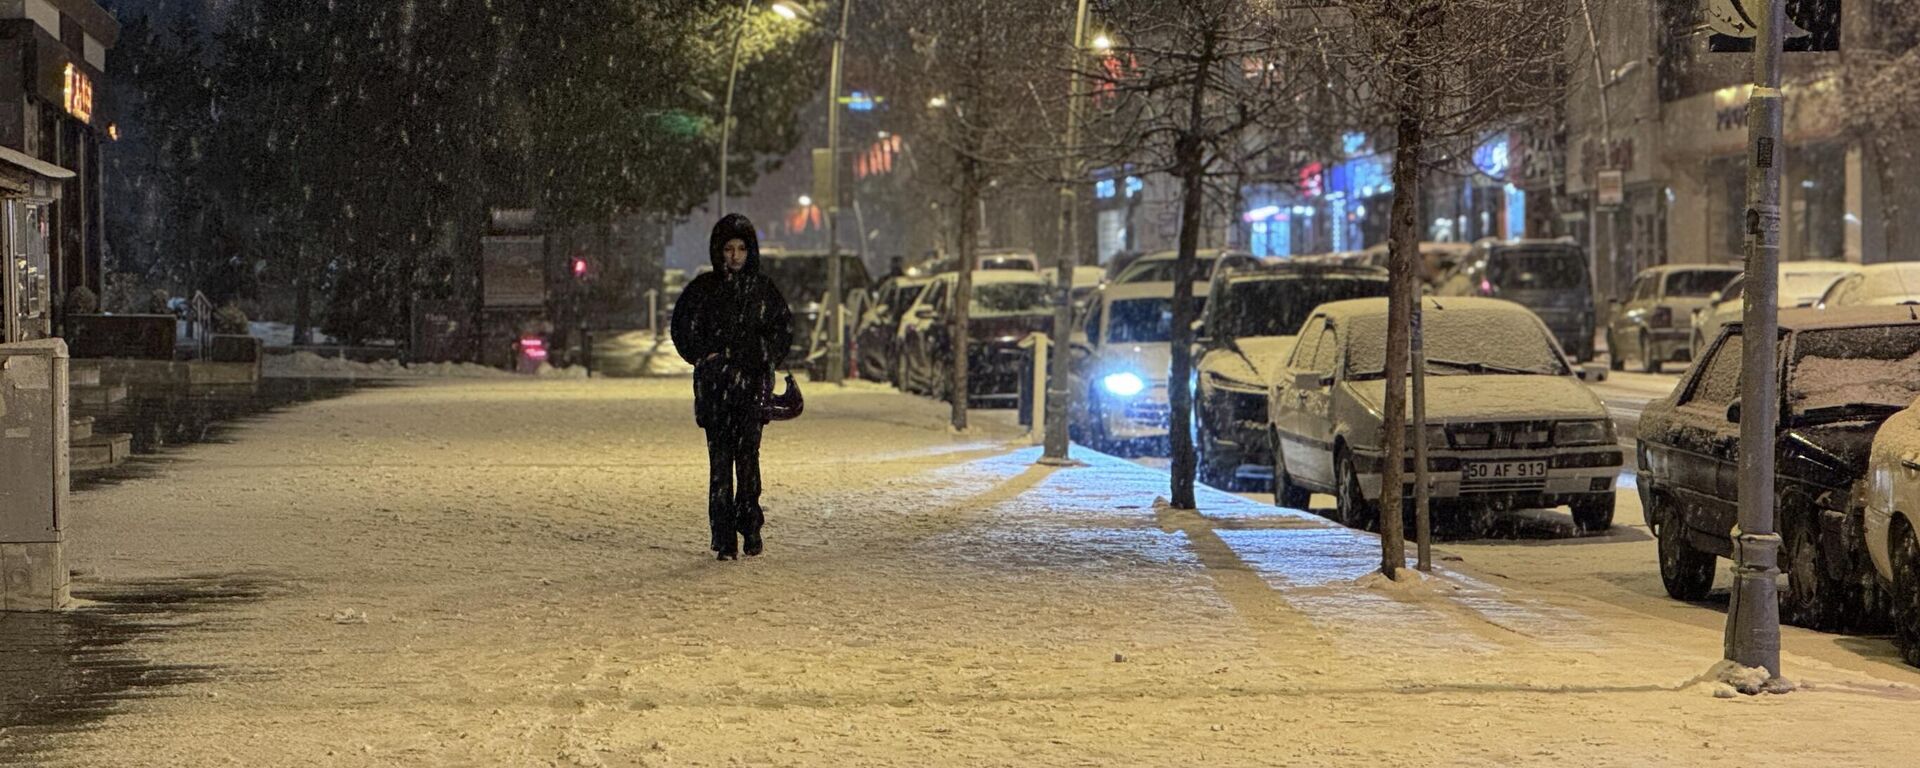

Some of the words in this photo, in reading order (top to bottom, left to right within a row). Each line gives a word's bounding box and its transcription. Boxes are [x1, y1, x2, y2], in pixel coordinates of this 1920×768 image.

[1470, 464, 1487, 477] 50
[1494, 463, 1512, 477] AF
[1518, 462, 1545, 476] 913
